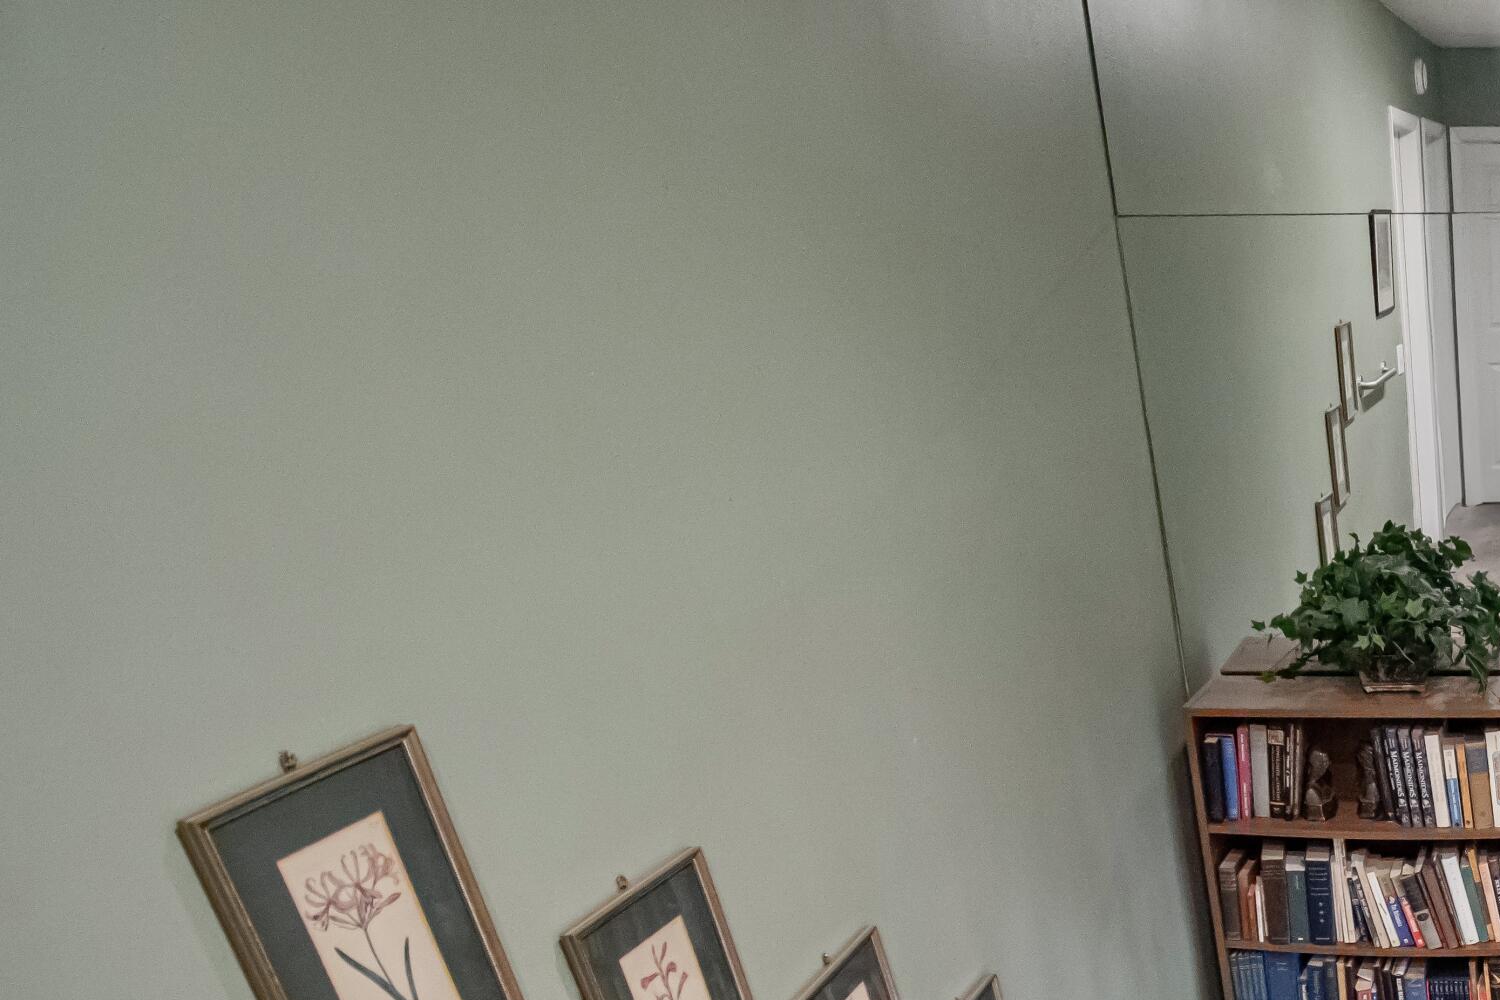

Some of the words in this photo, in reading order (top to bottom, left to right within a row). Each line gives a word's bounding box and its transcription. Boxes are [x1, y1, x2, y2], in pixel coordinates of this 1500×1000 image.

[1392, 750, 1405, 797] MAIMONIDES
[1403, 751, 1417, 798] MAIMONIDES
[1416, 751, 1429, 799] MAIMONIDES
